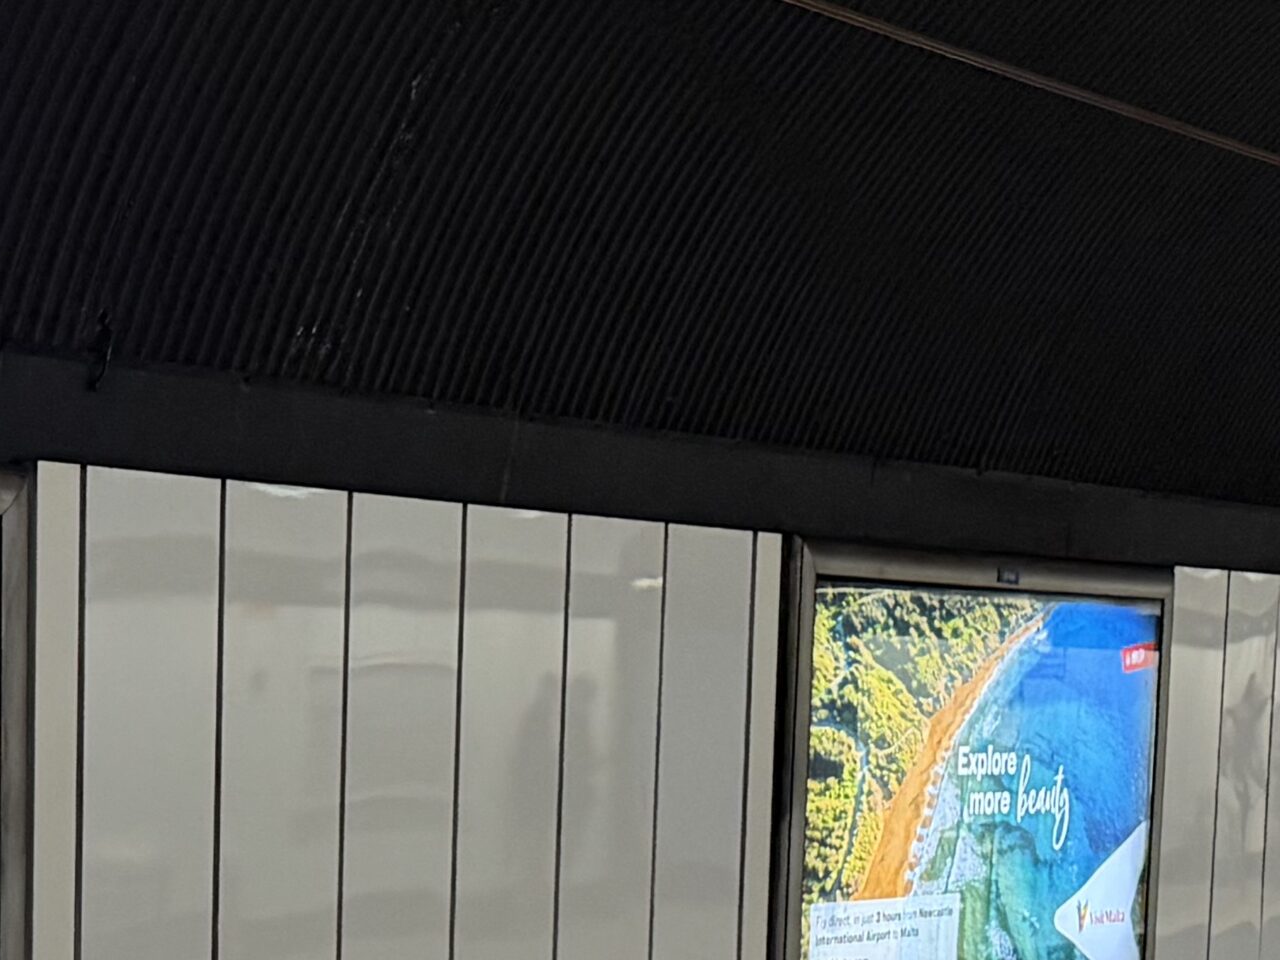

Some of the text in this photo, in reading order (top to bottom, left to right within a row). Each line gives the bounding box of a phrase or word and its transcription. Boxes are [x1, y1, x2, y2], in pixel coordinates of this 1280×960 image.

[957, 744, 1017, 782] Explore
[969, 754, 1069, 850] more beauty
[883, 910, 901, 922] hours
[815, 930, 865, 947] International
[866, 928, 891, 943] Airport
[900, 927, 919, 938] Malta
